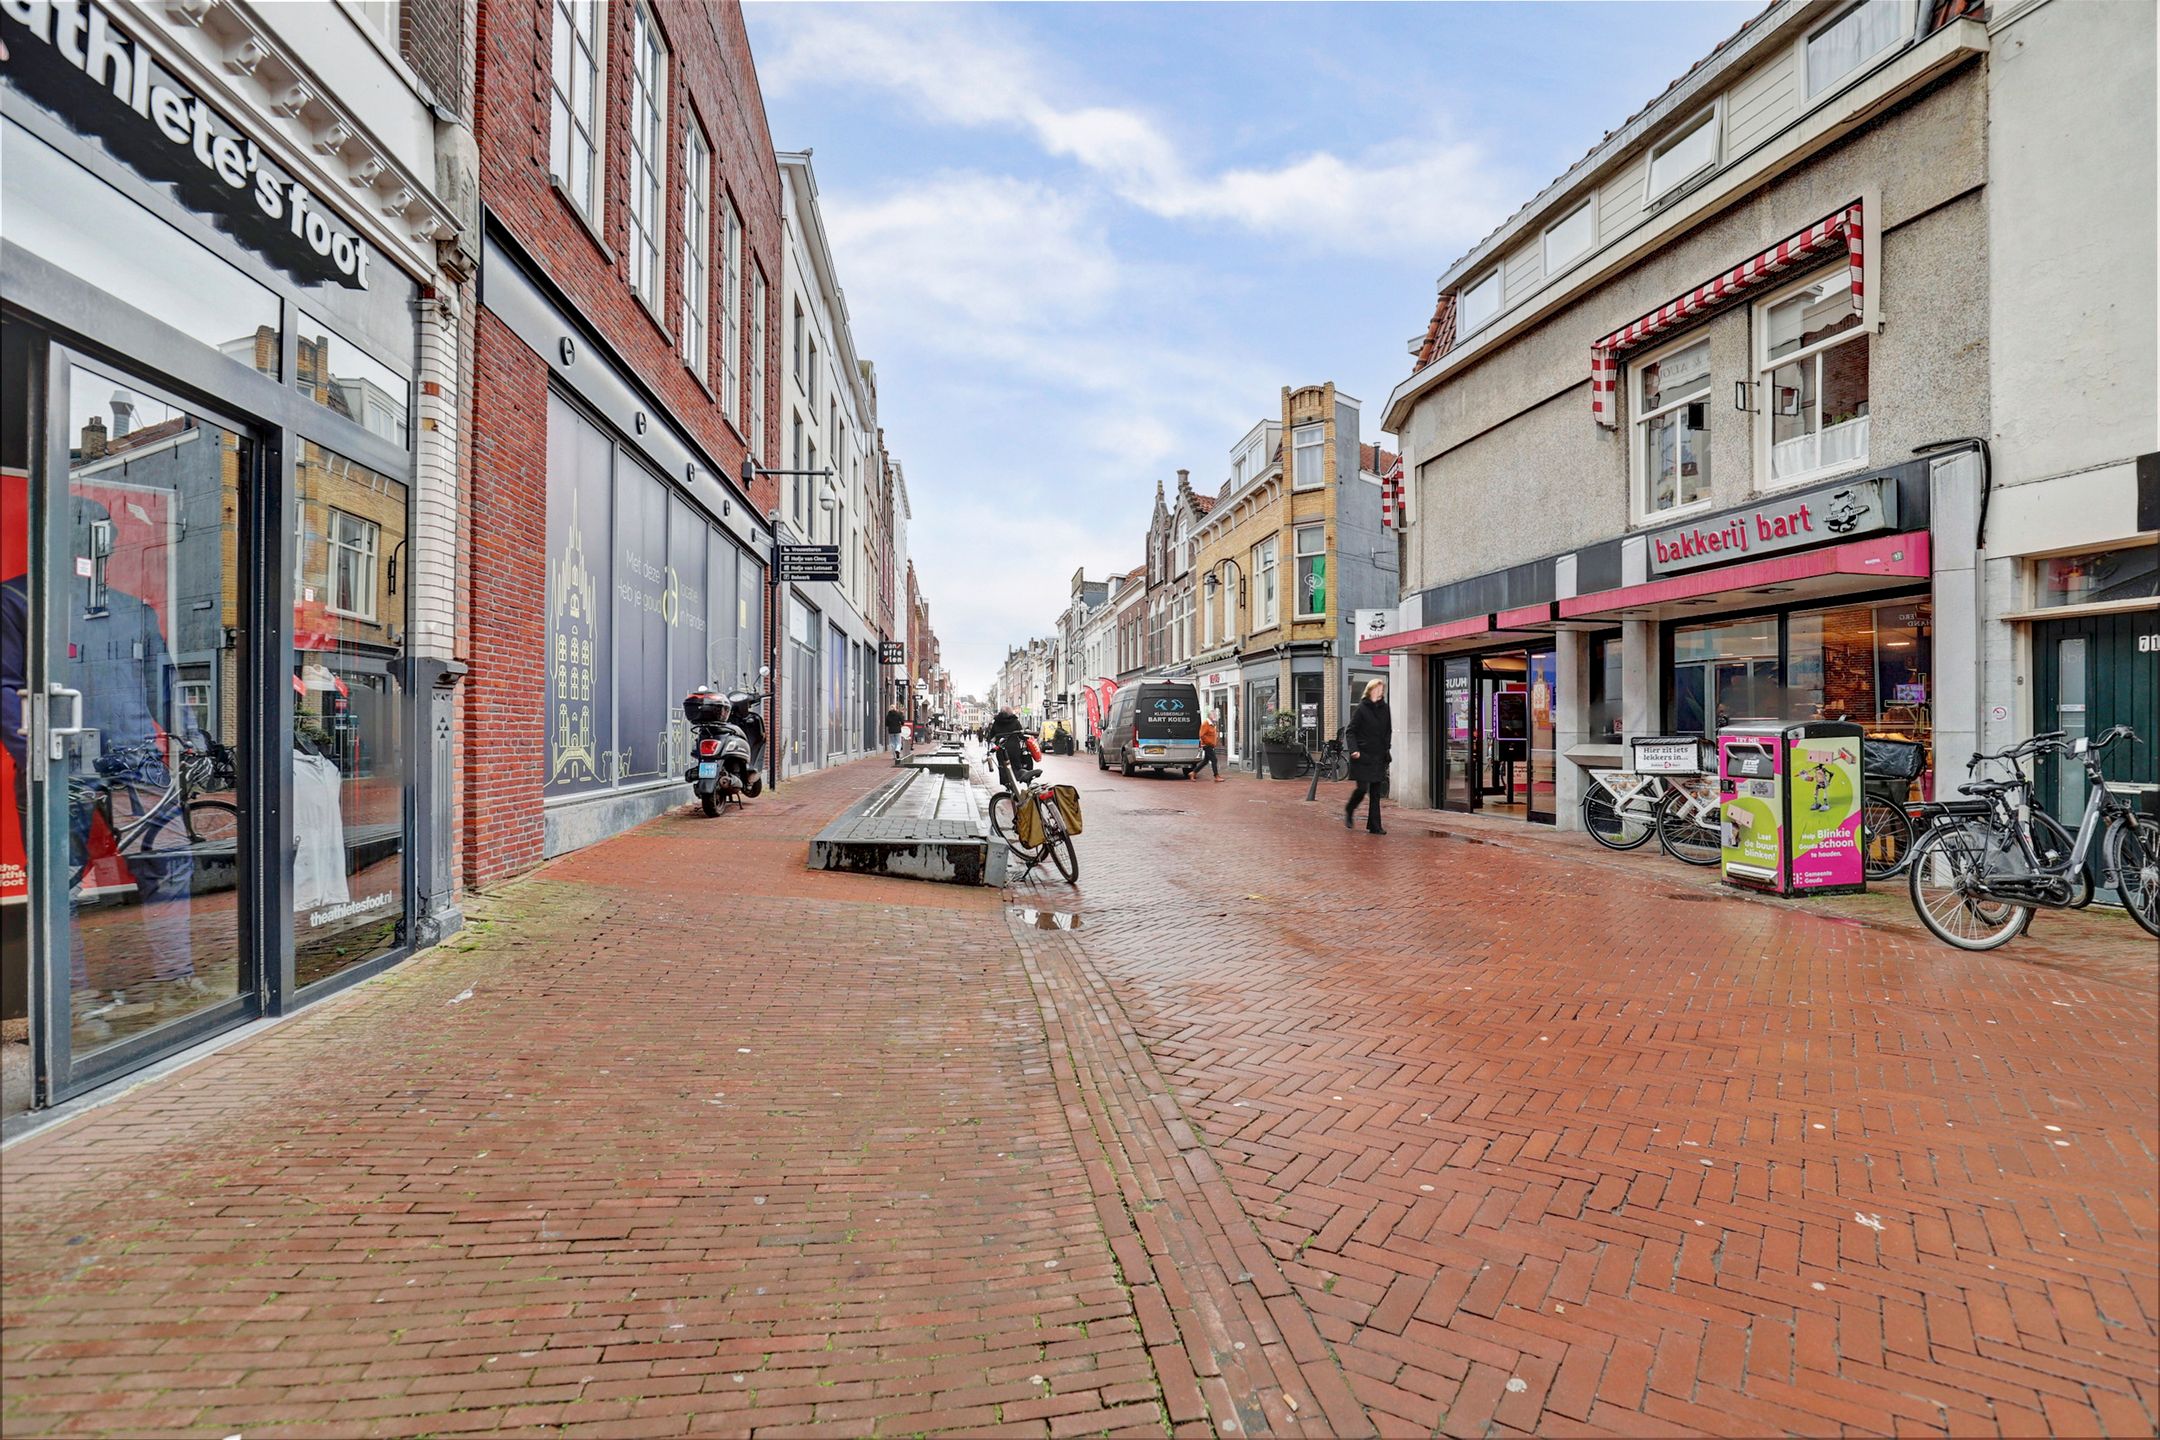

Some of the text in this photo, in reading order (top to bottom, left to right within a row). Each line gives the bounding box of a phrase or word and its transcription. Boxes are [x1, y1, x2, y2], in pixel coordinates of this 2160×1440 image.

[1654, 503, 1813, 563] bakkerij bart
[1817, 827, 1851, 839] Blinkie
[1744, 840, 1777, 851] de buurt
[1819, 839, 1854, 849] schoon
[1744, 848, 1776, 860] blinken!
